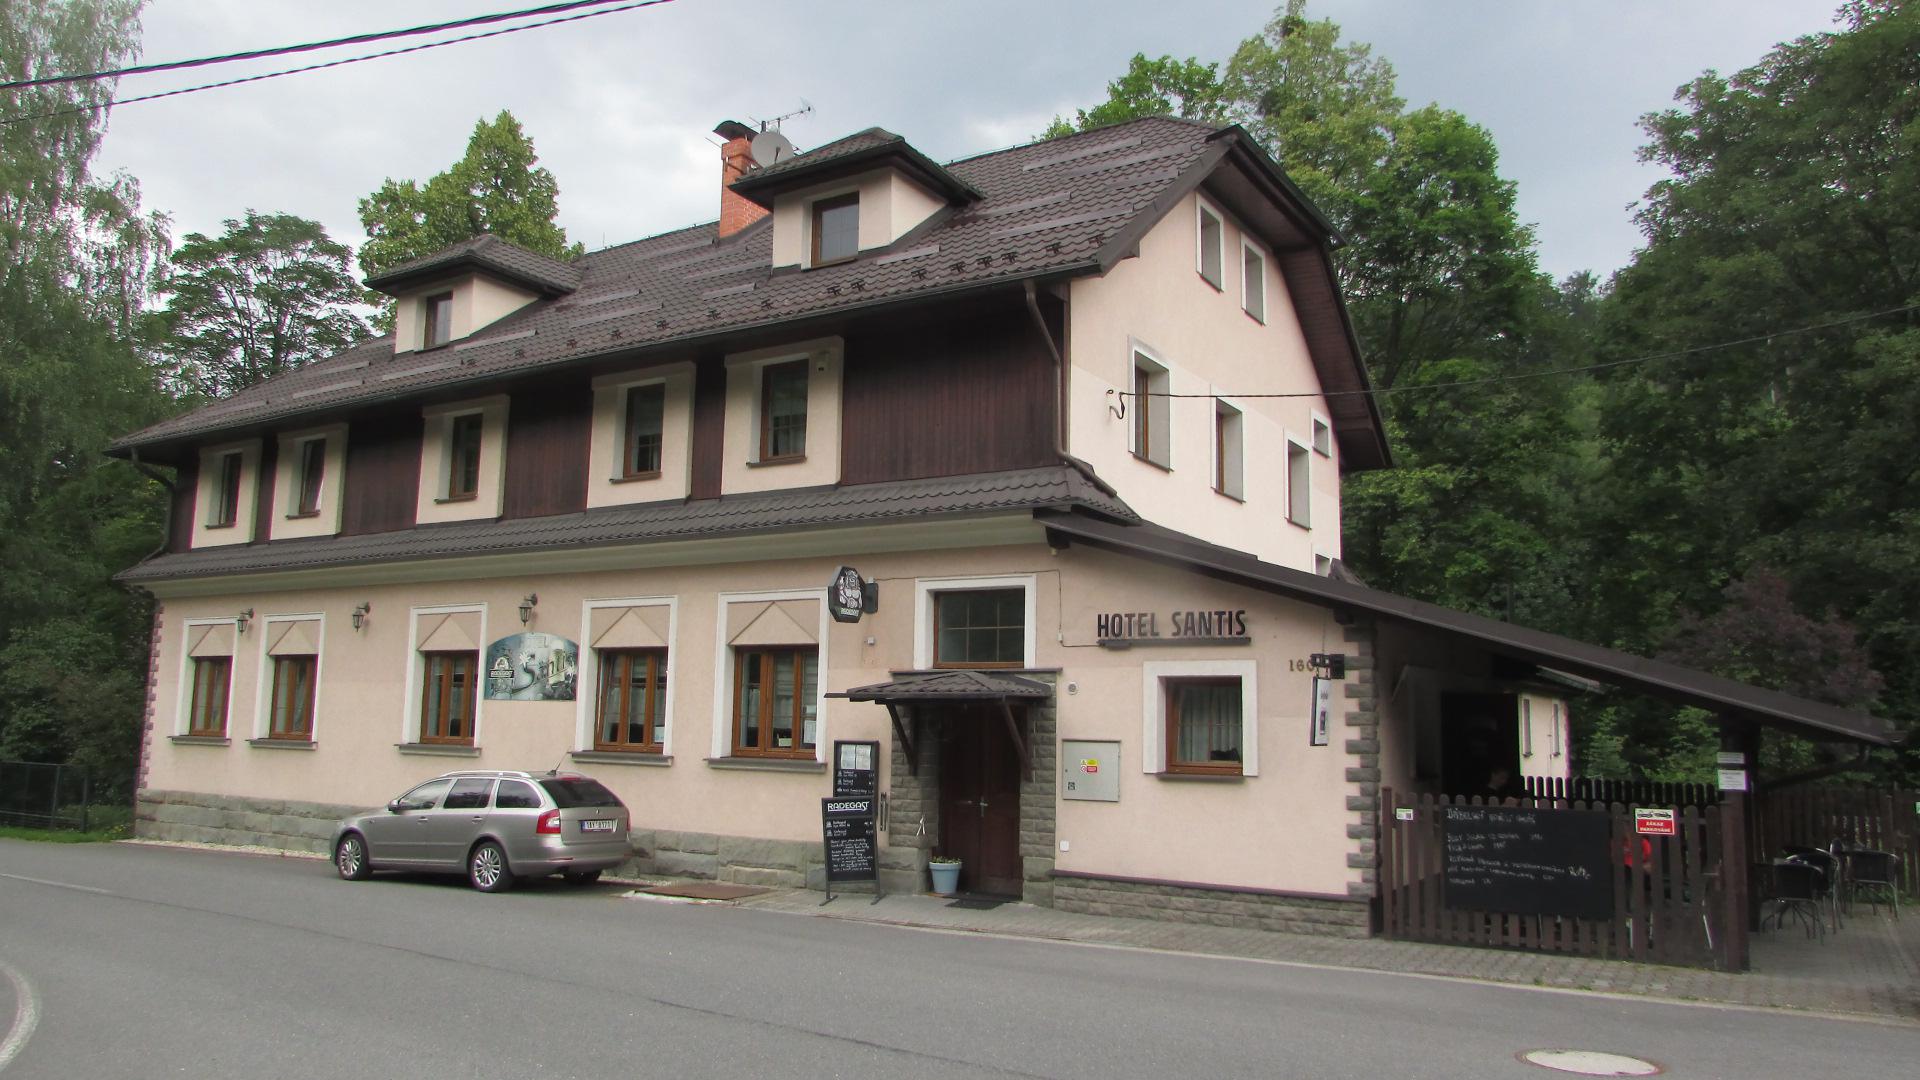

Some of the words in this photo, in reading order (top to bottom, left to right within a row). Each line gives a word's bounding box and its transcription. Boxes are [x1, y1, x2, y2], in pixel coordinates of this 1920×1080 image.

[1097, 612, 1160, 638] HOTEL
[1171, 610, 1246, 637] SANTIS
[827, 801, 870, 812] RADEGAST
